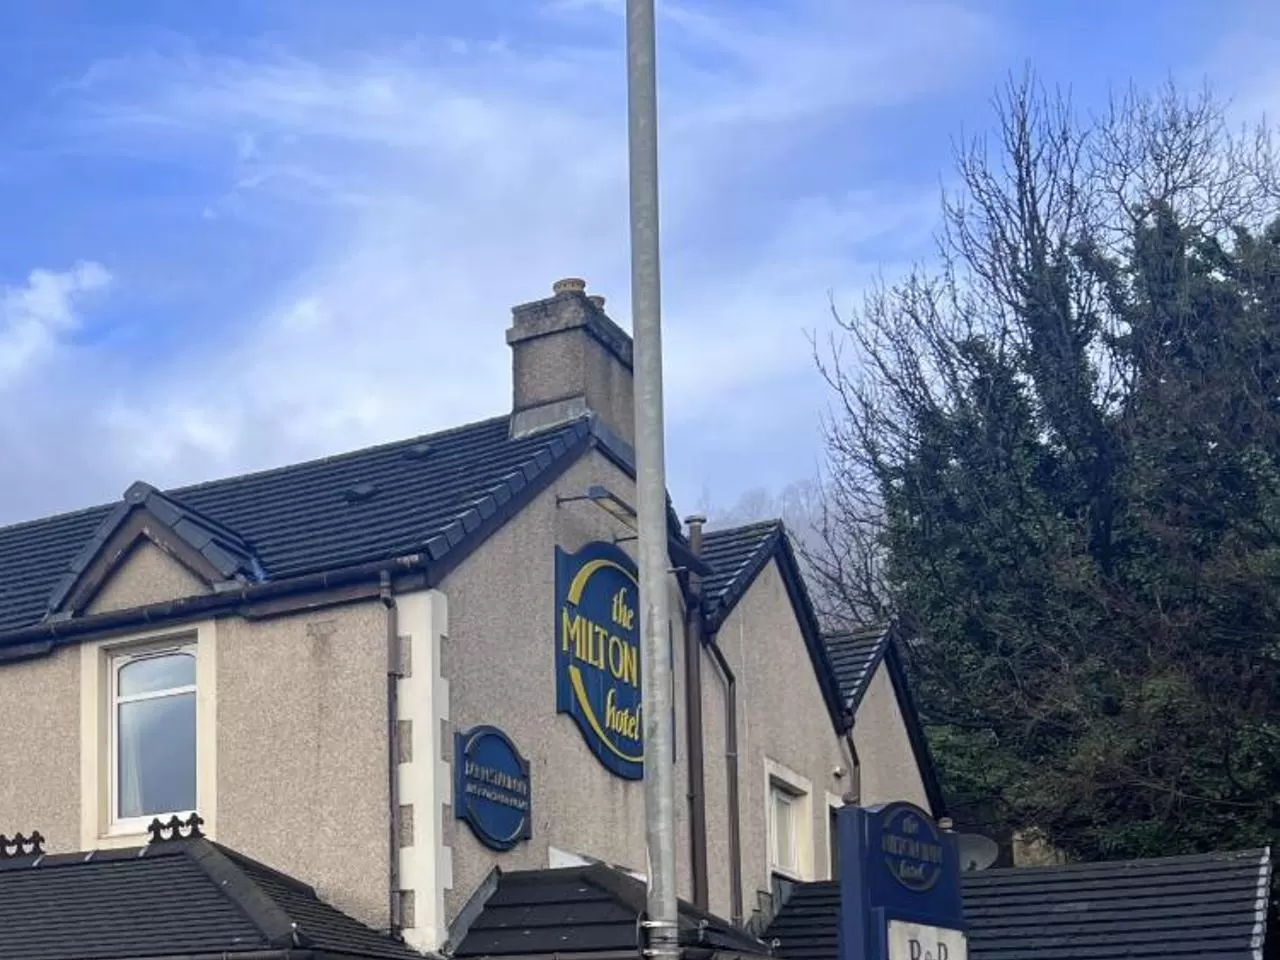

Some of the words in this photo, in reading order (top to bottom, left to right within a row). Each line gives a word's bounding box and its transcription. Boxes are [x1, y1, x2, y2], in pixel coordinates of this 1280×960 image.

[612, 586, 634, 631] the
[562, 605, 638, 688] MILTON
[605, 687, 642, 741] hotel
